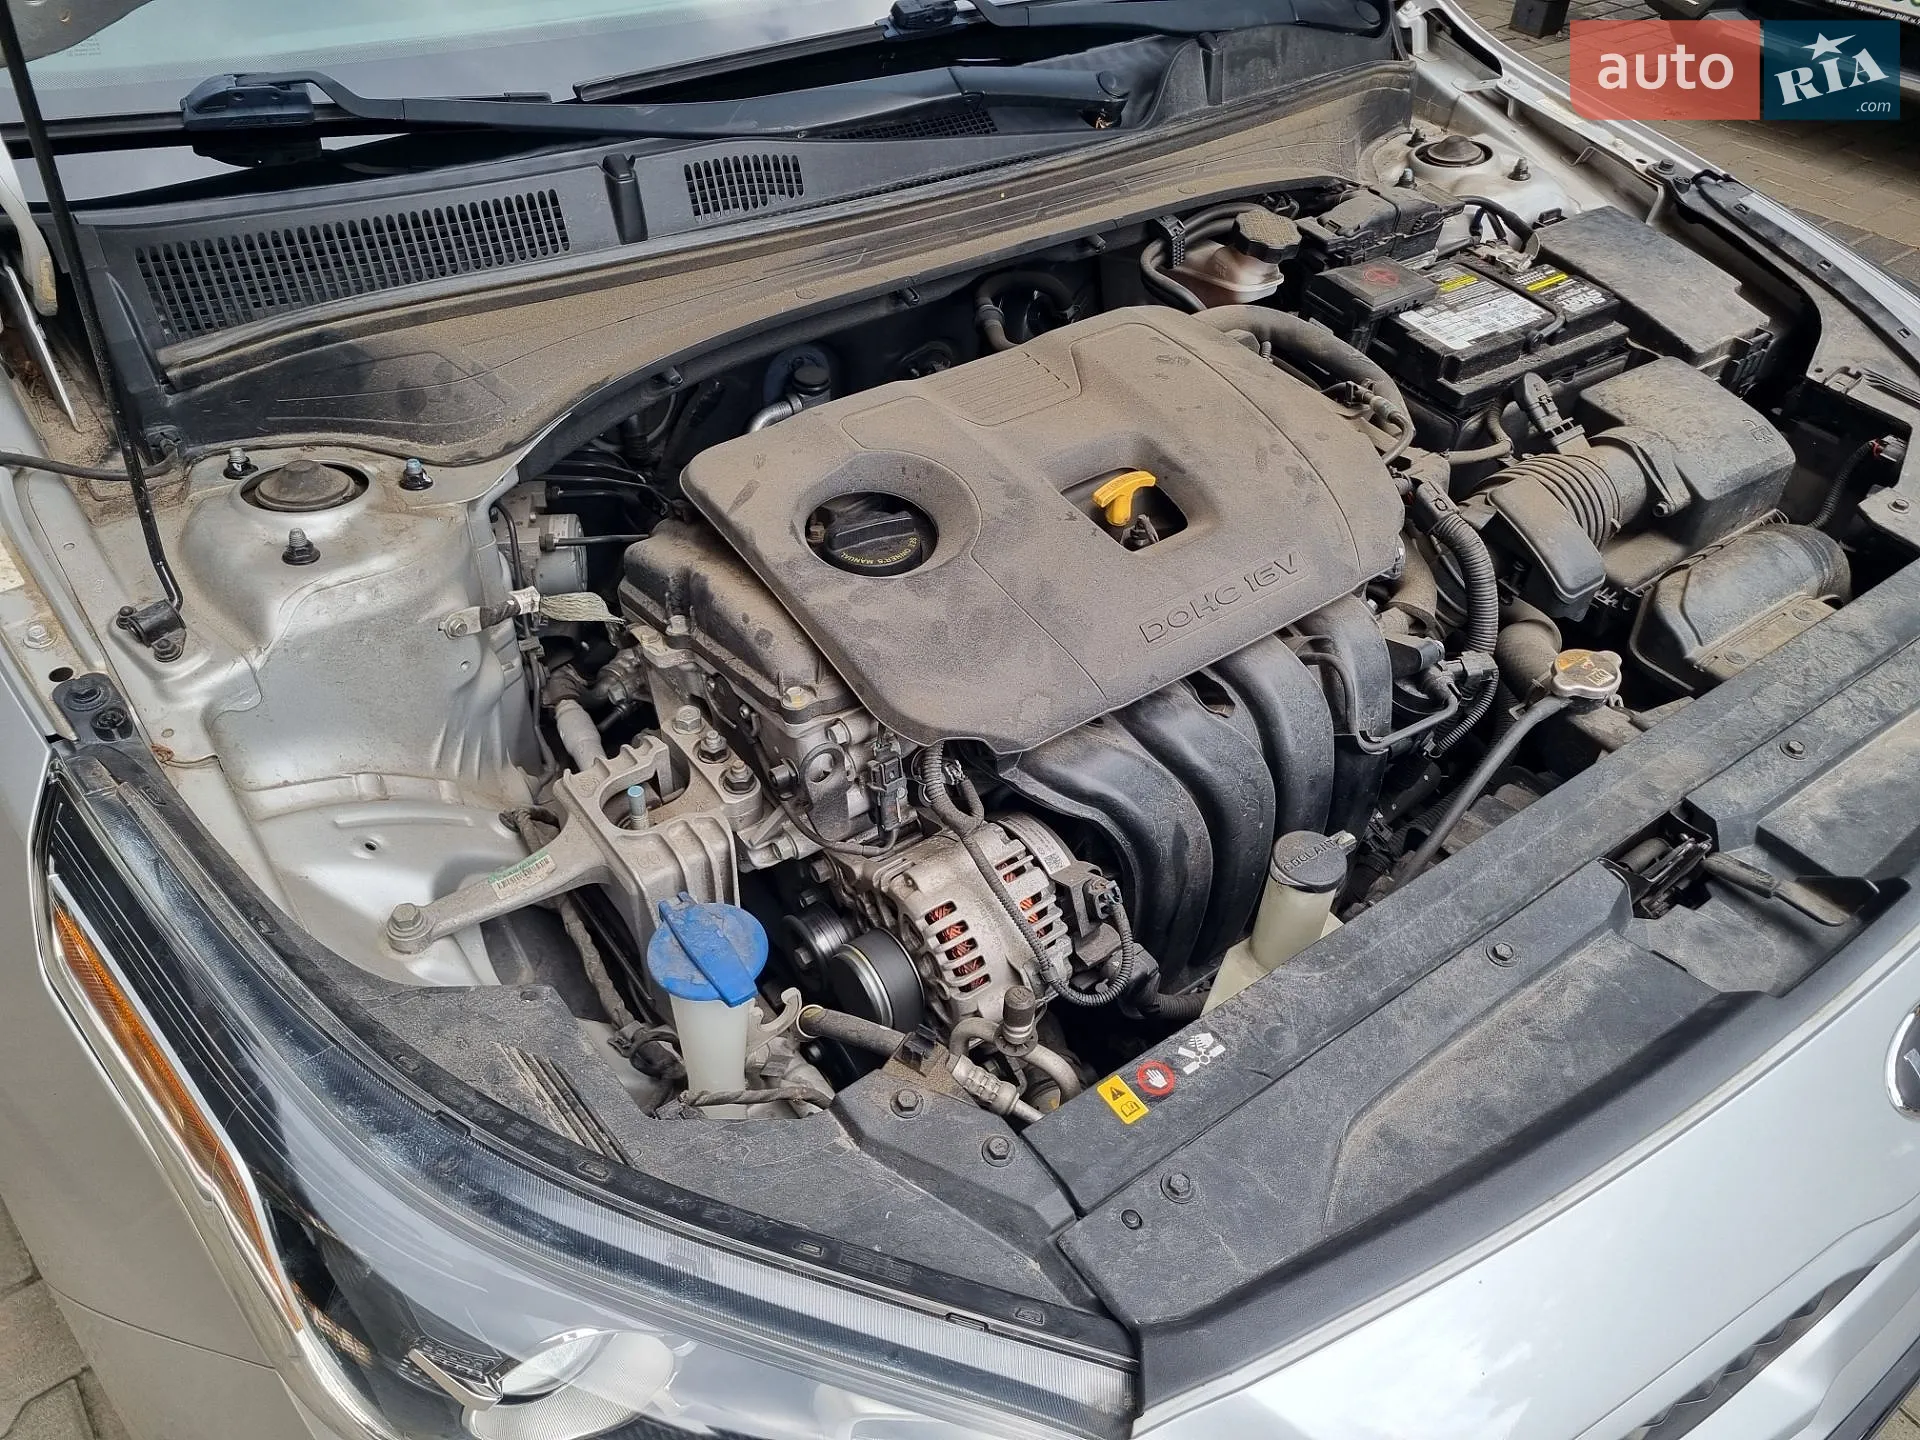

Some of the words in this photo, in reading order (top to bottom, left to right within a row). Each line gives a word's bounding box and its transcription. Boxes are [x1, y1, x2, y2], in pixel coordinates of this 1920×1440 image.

[840, 551, 874, 564] MANUAL
[877, 548, 912, 564] OWNER'S
[1139, 583, 1242, 643] DOHC
[1243, 553, 1299, 593] 16V
[1283, 836, 1341, 873] COOLANT
